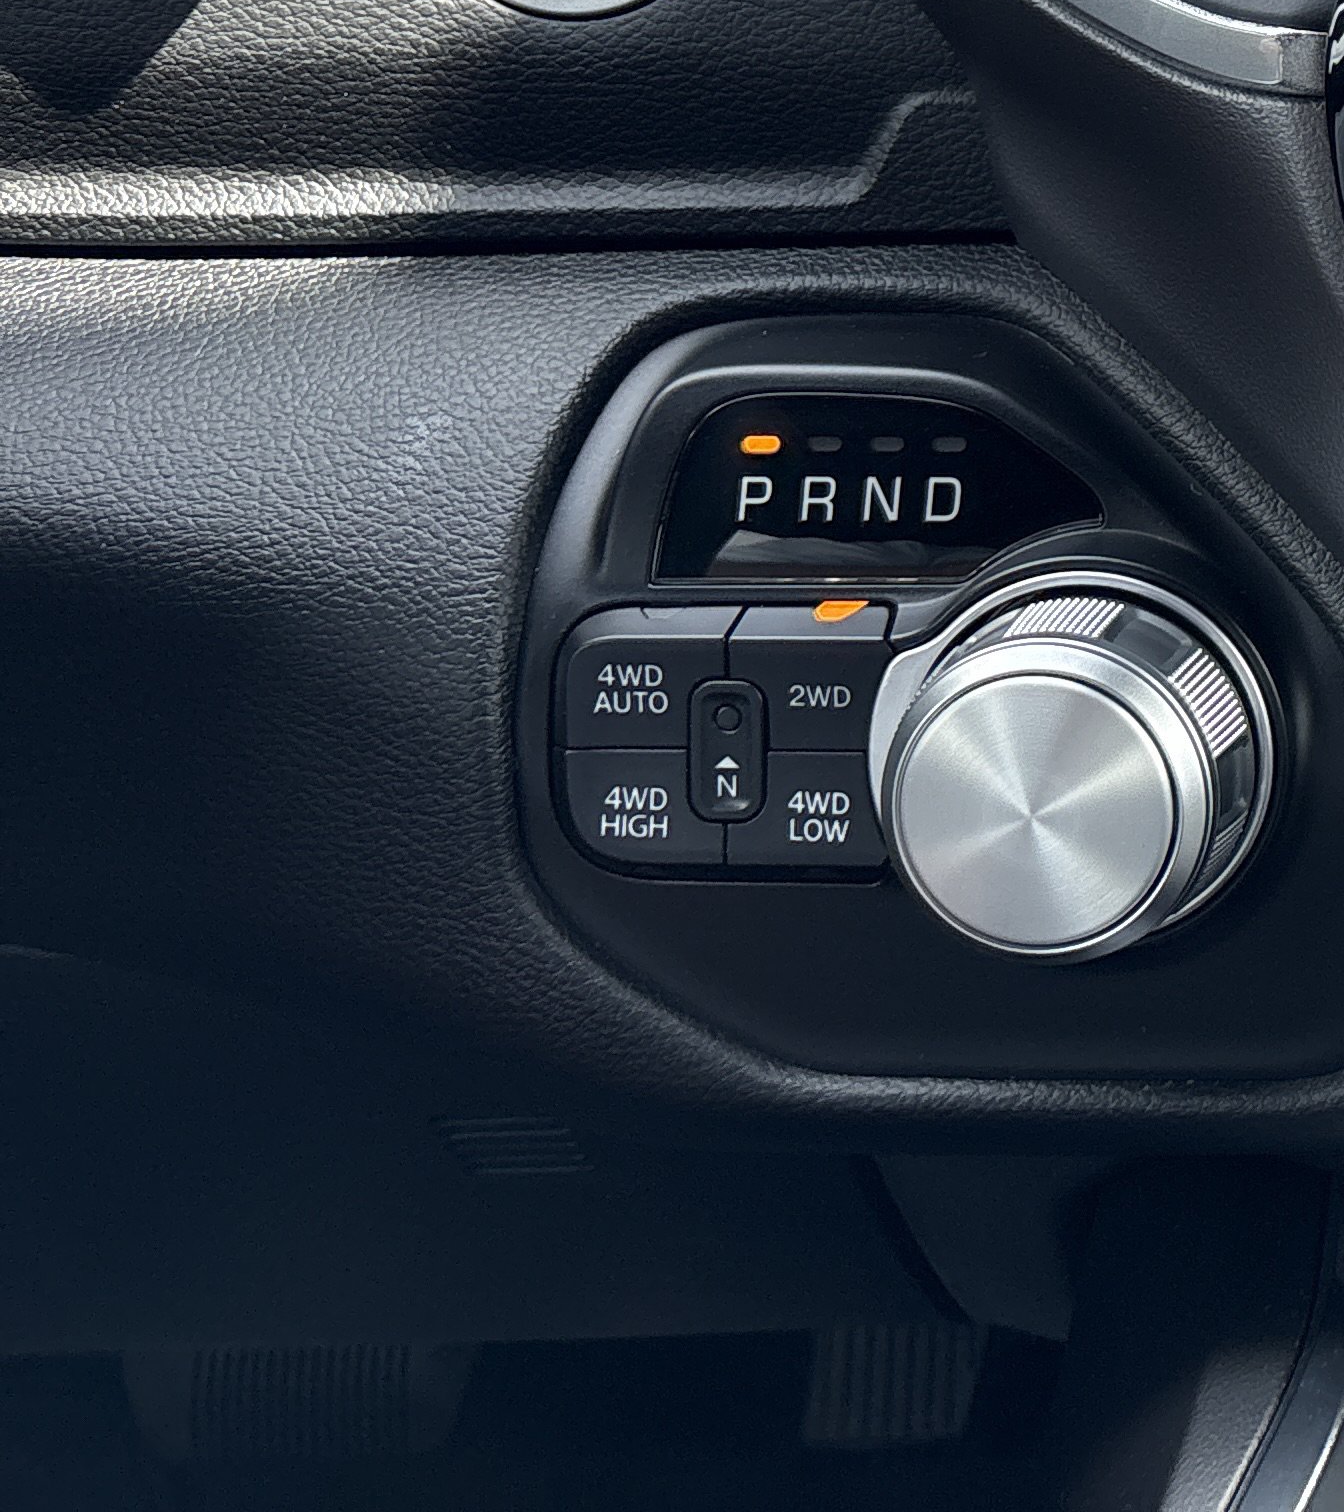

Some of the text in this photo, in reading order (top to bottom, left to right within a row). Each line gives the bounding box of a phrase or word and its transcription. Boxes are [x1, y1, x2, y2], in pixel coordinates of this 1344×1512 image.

[737, 476, 963, 522] P R N D
[597, 664, 663, 686] 4WD
[593, 691, 669, 714] AUTO
[788, 686, 852, 709] 2WD
[717, 774, 737, 798] N
[604, 787, 668, 811] 4WD
[788, 791, 851, 816] 4WD
[600, 814, 669, 838] HIGH
[789, 818, 850, 842] LOW
